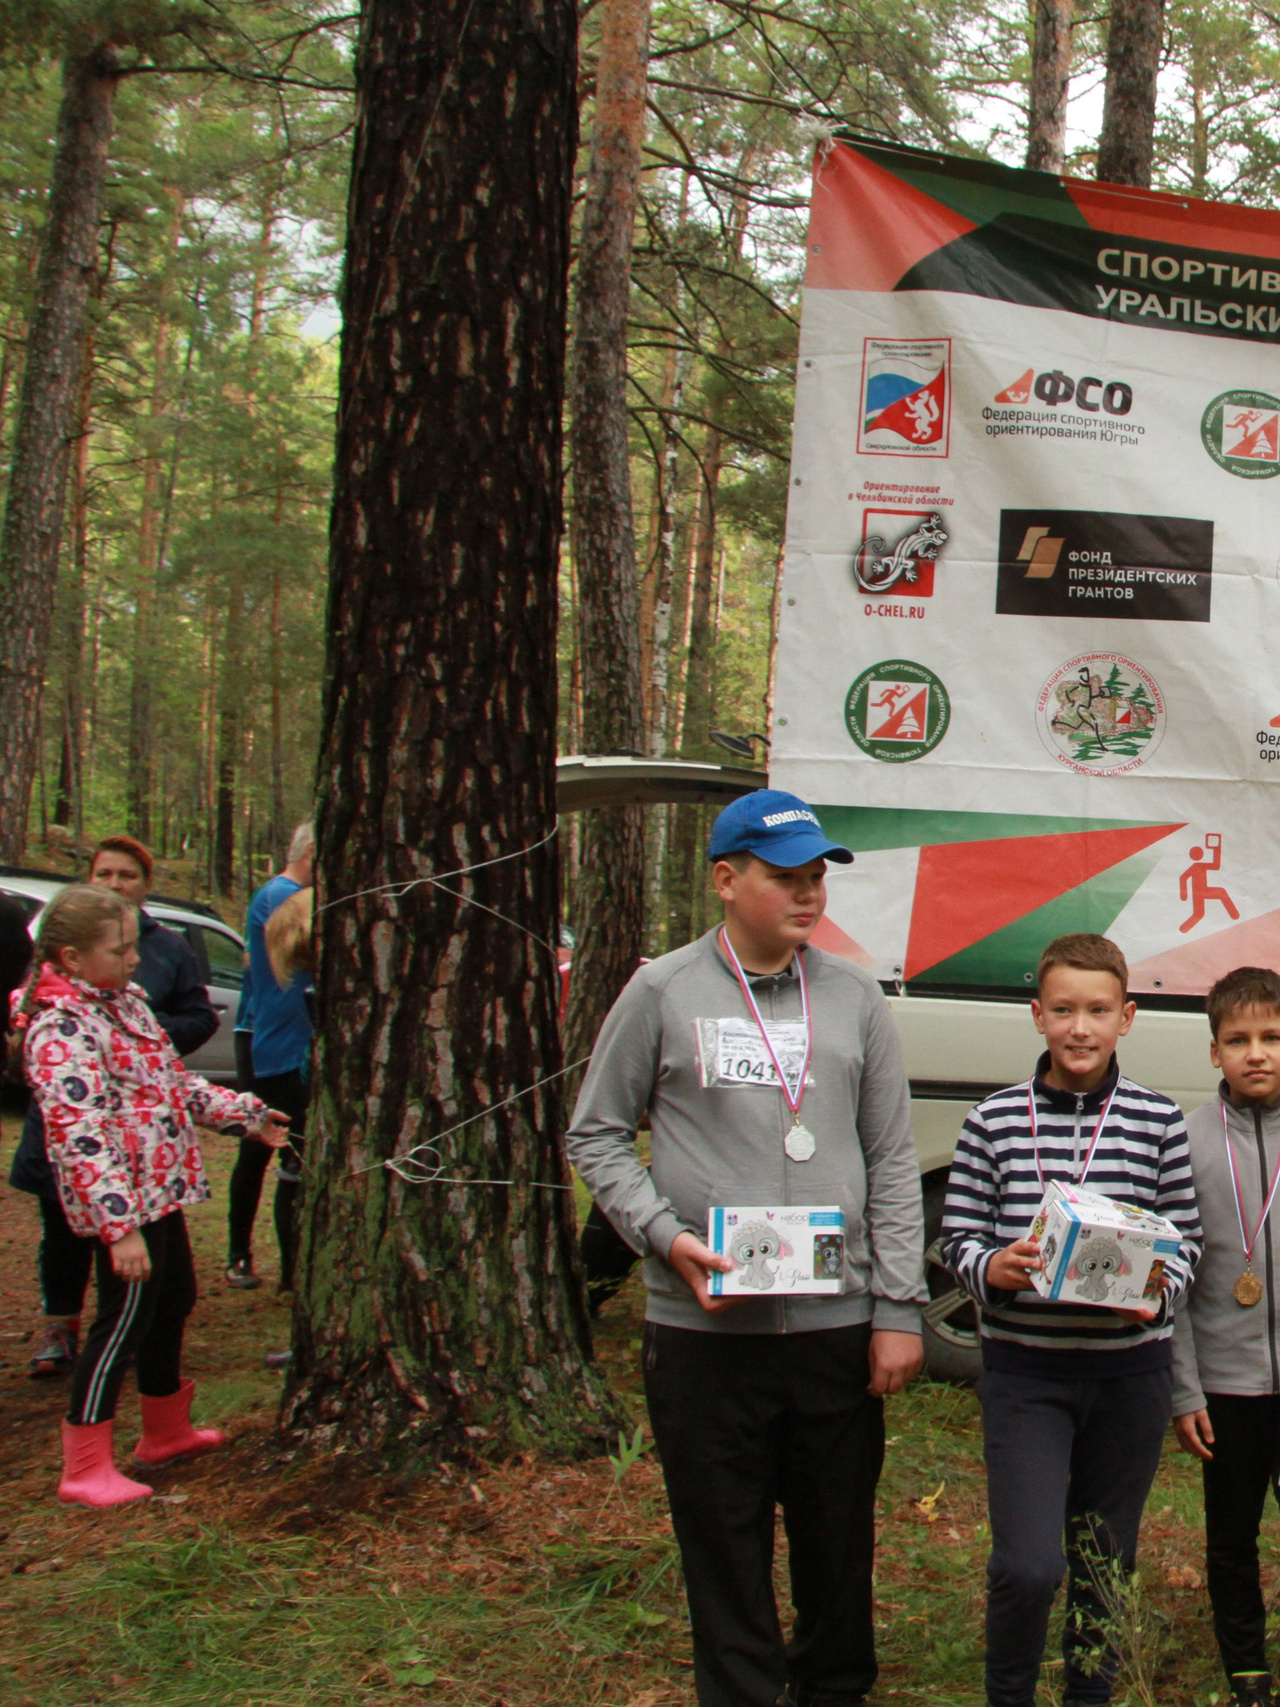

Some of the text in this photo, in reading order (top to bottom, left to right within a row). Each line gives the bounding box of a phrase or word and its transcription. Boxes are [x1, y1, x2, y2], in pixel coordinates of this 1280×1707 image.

[1033, 369, 1133, 416] ФСО
[982, 406, 1145, 435] Федерация спортивного
[985, 424, 1138, 446] ориентирования Югры
[1068, 551, 1112, 565] ФОНД
[1068, 568, 1197, 585] ПРЕЗИДЕНТСКИХ
[1068, 585, 1134, 599] ГРАНТОВ
[864, 604, 925, 619] O-CHEL.RU
[1038, 654, 1164, 714] ФЕДЕРАЦИЯ СПОРТИВНОГО ОРИЕНТИРОВАНИЯ
[1057, 753, 1143, 777] КУРГАНСКОЙ ОБЛАСТИ
